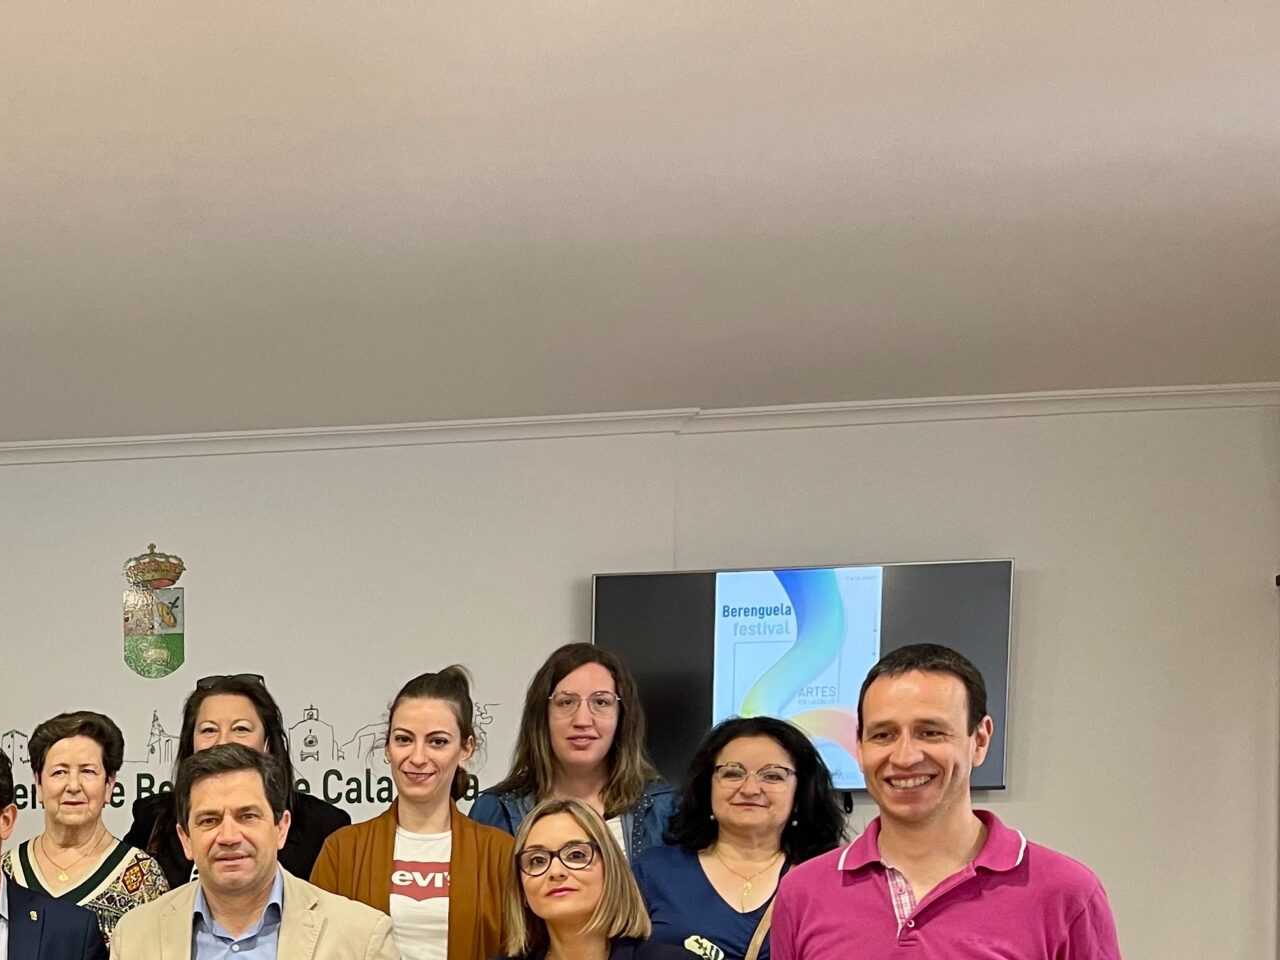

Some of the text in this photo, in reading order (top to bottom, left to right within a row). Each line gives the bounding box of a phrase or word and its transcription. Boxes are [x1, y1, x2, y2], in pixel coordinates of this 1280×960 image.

[722, 603, 792, 619] Berenguela
[733, 621, 790, 637] festival
[798, 686, 837, 697] ARTES
[110, 782, 125, 809] e
[294, 778, 310, 794] e
[323, 768, 479, 804] Calaa
